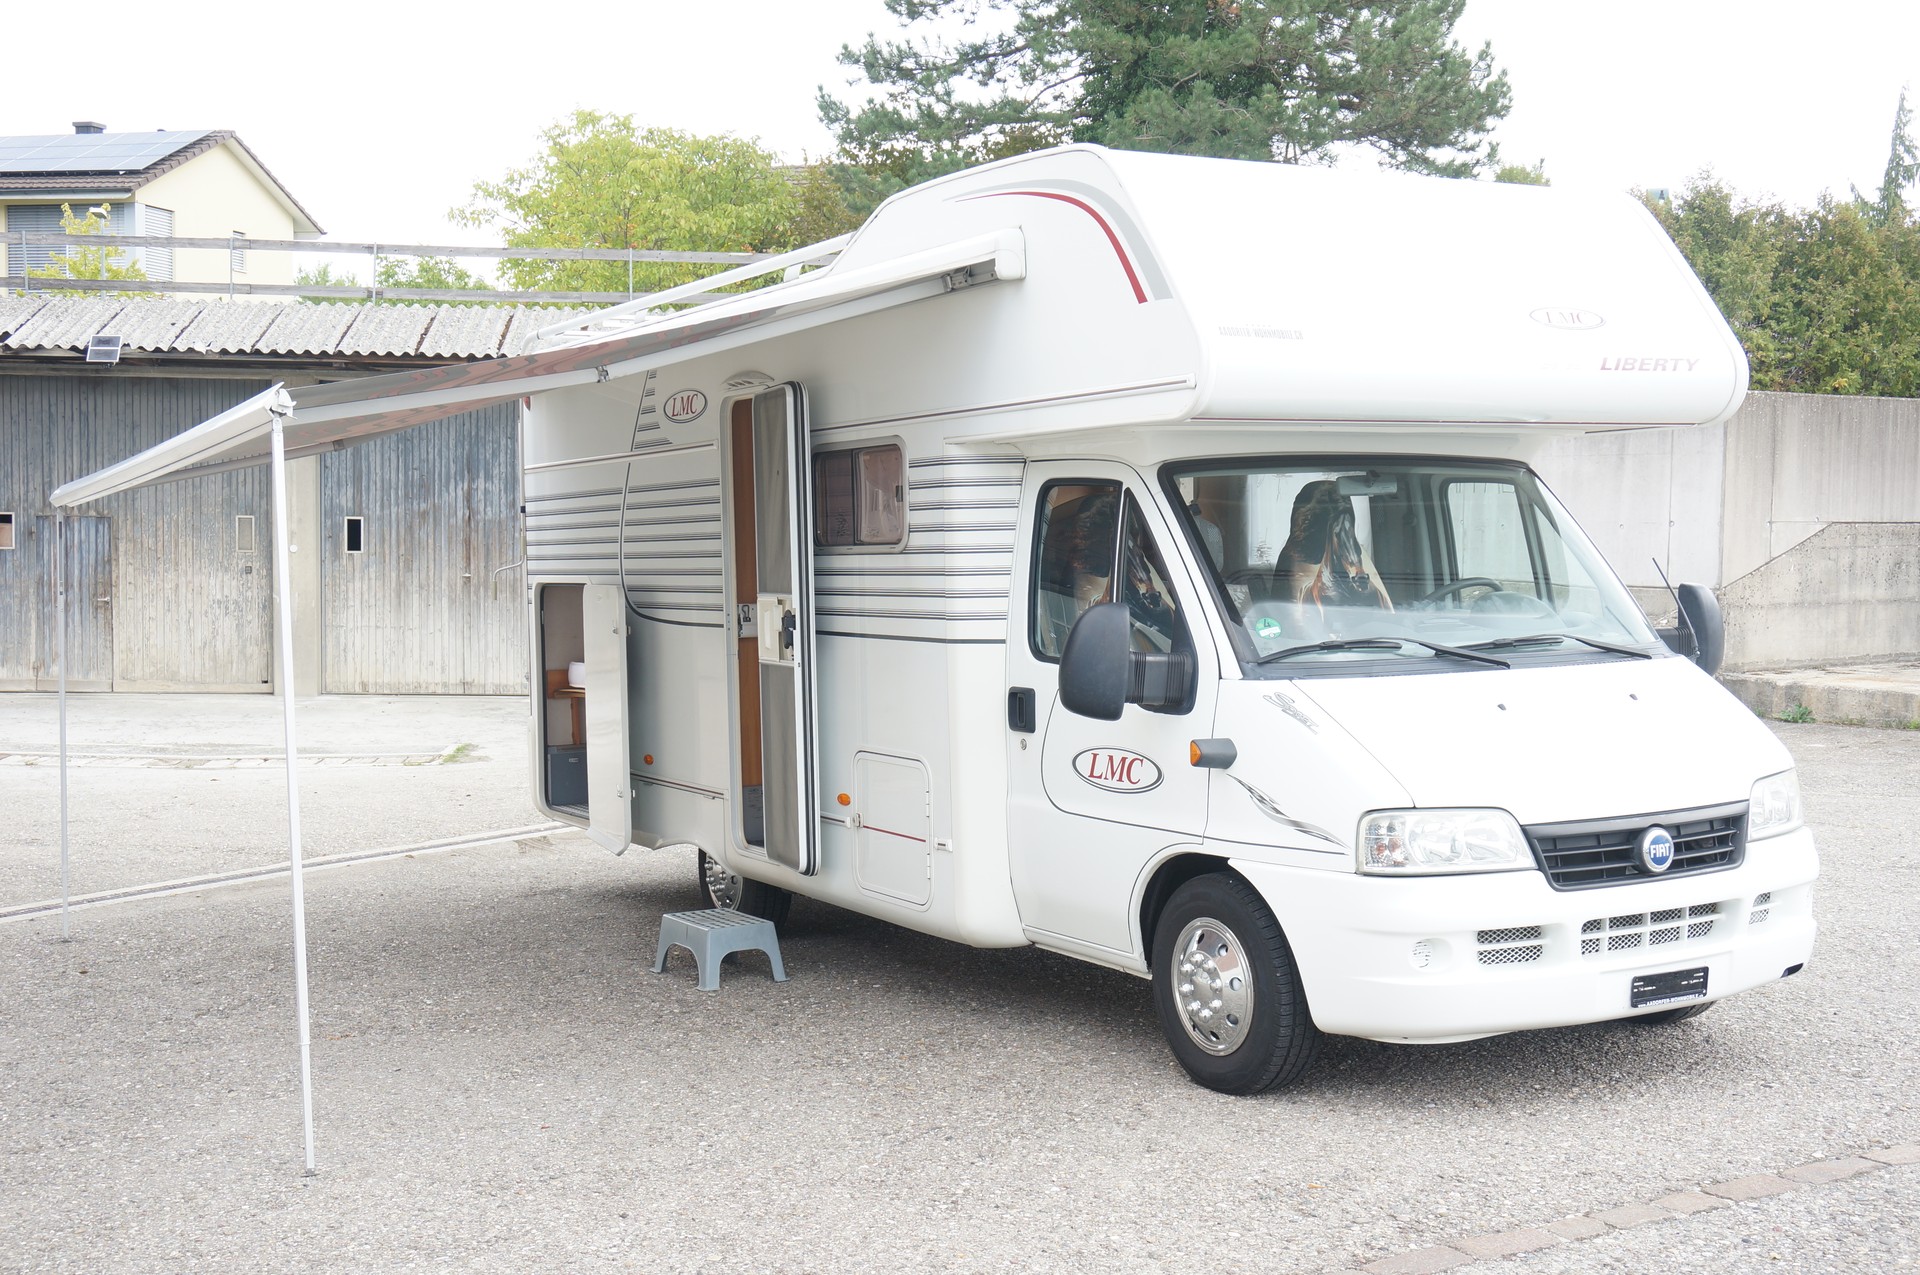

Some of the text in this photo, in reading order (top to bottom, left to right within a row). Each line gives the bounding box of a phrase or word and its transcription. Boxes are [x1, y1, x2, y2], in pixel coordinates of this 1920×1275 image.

[1600, 357, 1700, 372] LIBERTY
[672, 393, 698, 417] LMC
[1263, 618, 1271, 628] 4
[1088, 752, 1144, 784] LMC
[1650, 842, 1670, 859] FIAT
